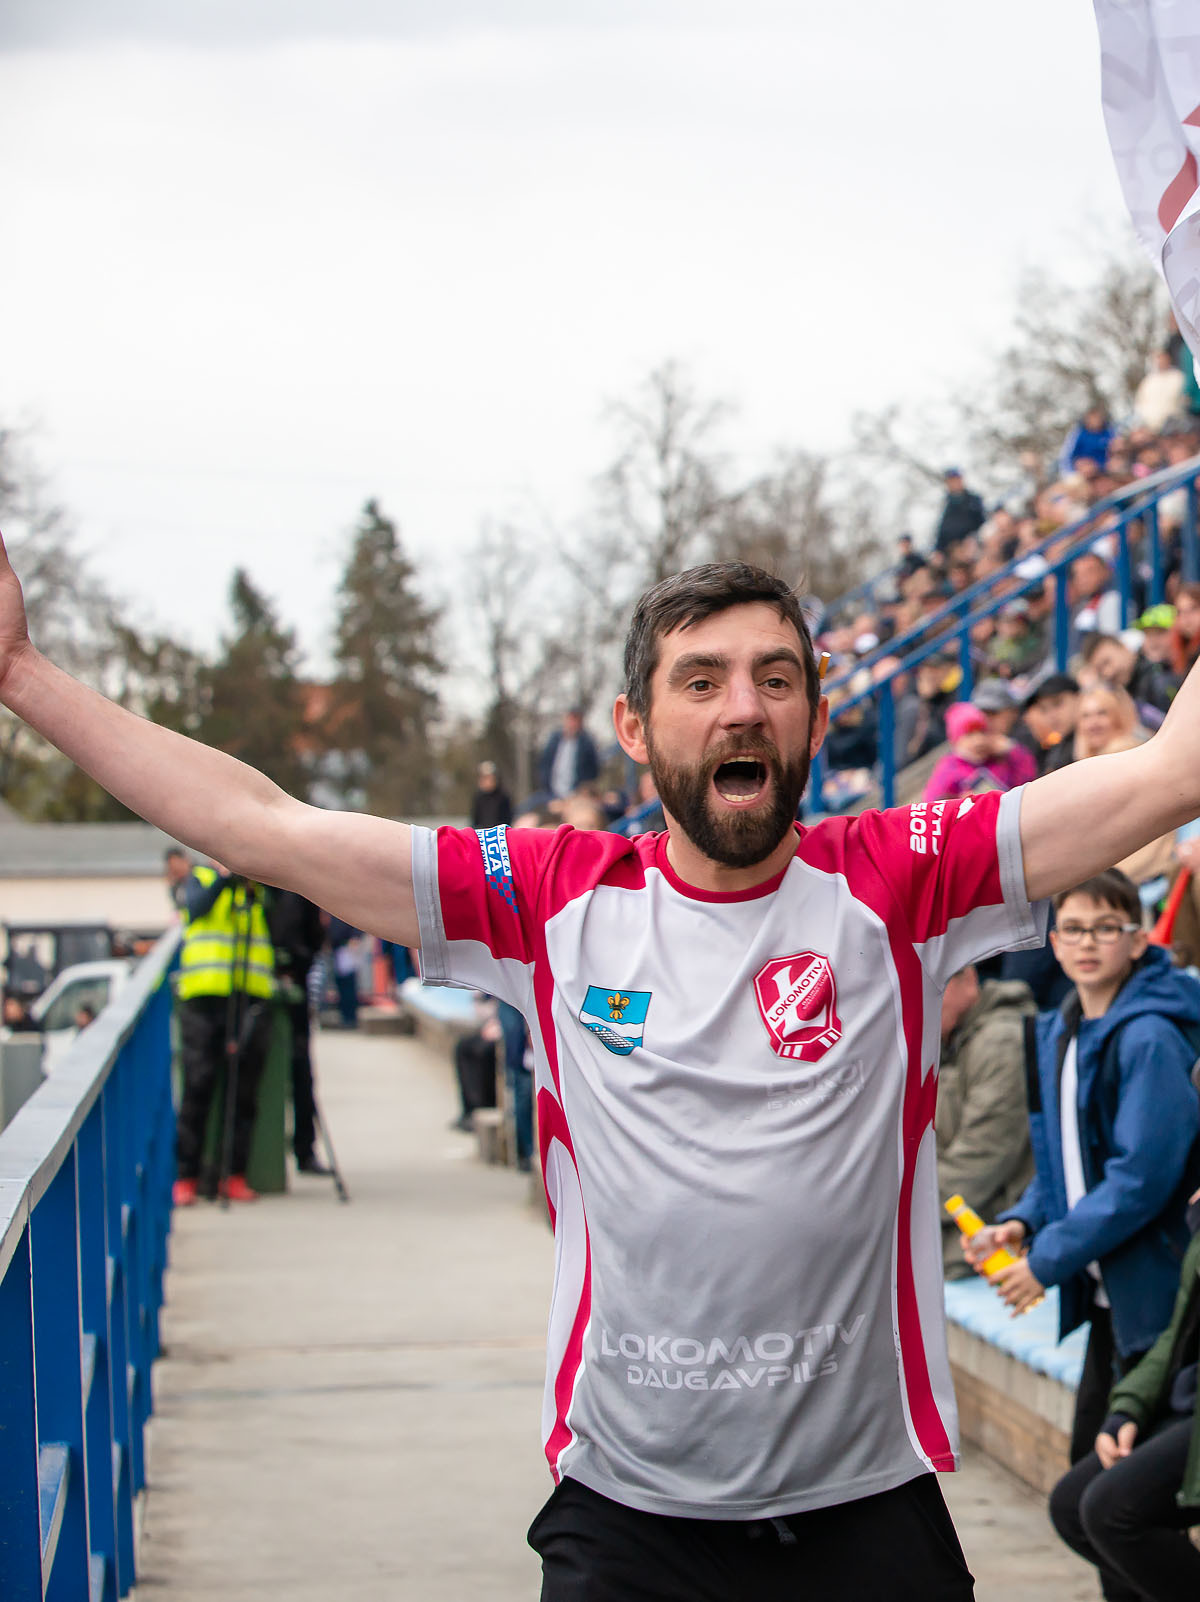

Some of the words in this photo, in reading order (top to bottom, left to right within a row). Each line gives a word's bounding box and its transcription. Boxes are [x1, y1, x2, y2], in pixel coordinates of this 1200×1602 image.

[485, 828, 503, 872] LIGA
[909, 802, 928, 854] 2015
[769, 961, 823, 1023] LOKOMOTIV
[600, 1313, 867, 1366] LOKOMOTIV
[626, 1352, 839, 1391] DAUGAVPILS
